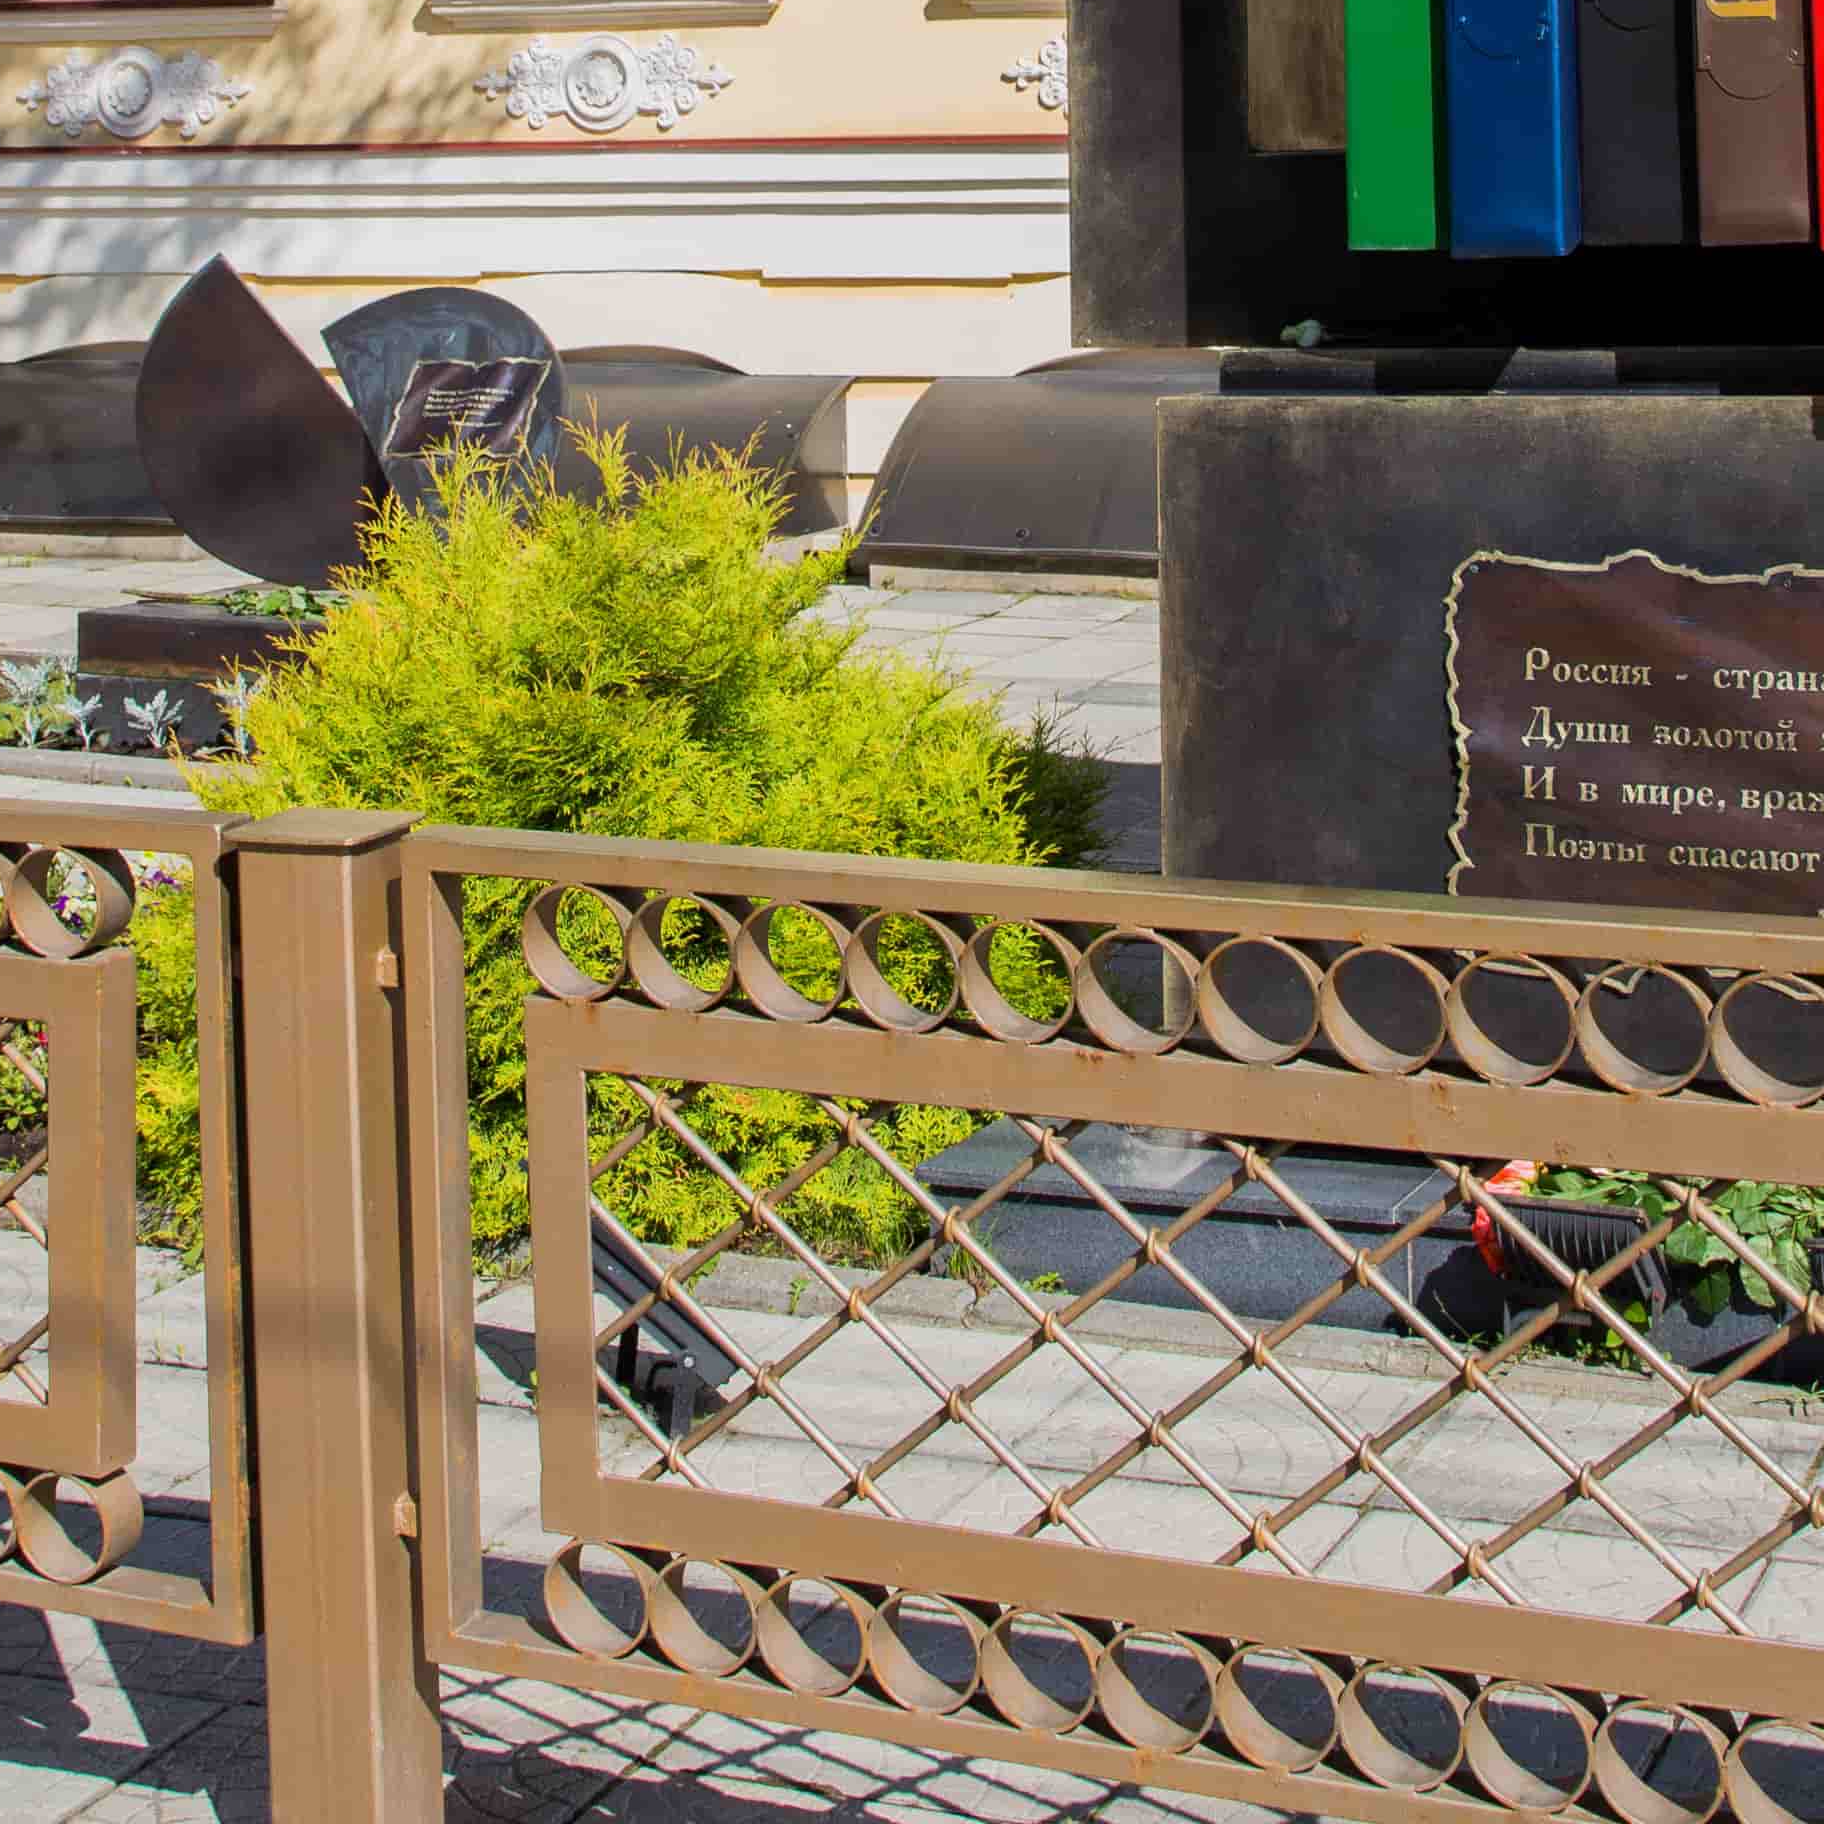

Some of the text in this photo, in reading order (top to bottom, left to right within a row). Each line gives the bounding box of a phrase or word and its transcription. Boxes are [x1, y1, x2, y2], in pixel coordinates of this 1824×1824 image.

[1524, 647, 1653, 687] Россия
[1520, 706, 1631, 750] Души
[1653, 718, 1798, 753] золотой
[1521, 765, 1558, 802] И
[1578, 780, 1600, 803] в
[1620, 781, 1727, 817] мире,
[1523, 822, 1648, 864] Поэты
[1667, 842, 1821, 875] спасают
